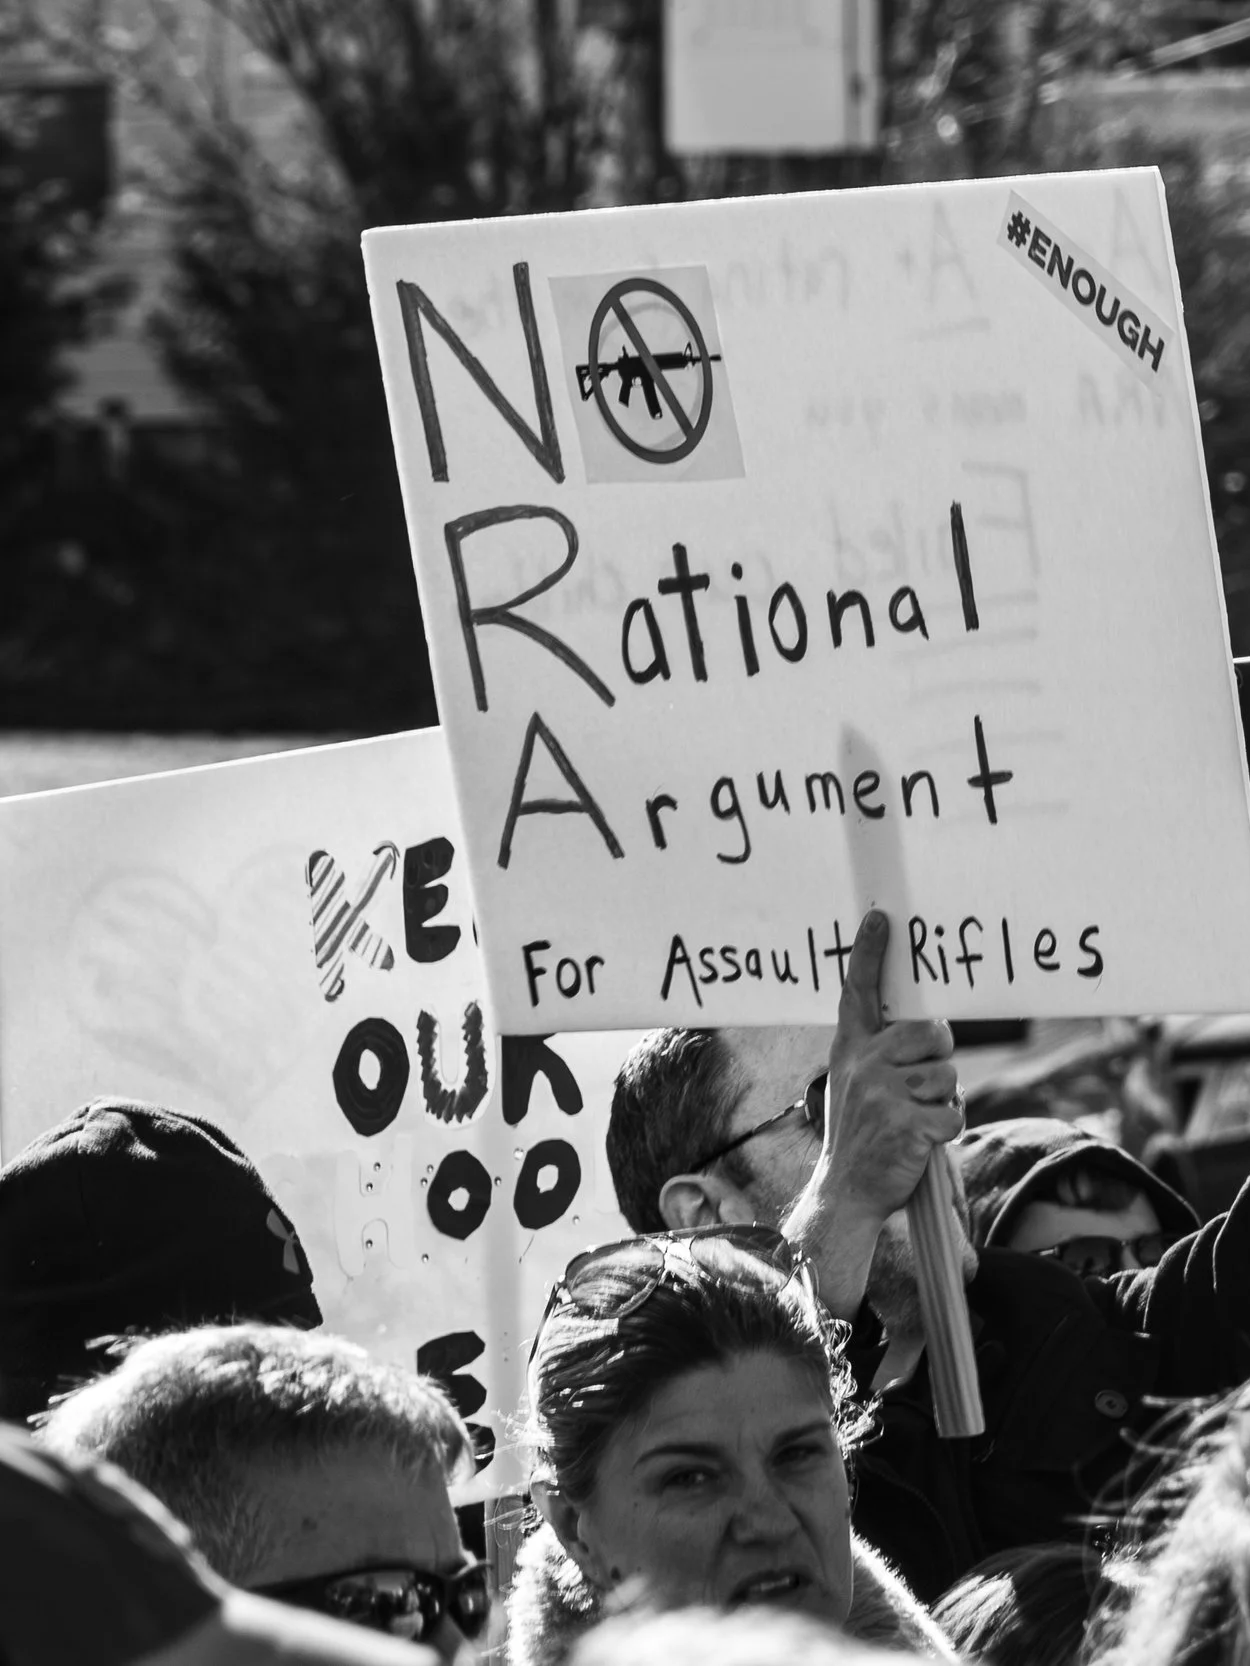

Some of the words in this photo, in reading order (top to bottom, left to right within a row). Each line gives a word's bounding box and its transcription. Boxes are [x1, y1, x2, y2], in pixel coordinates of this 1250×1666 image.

[1005, 210, 1165, 372] #ENOUGH
[443, 500, 980, 712] Rational
[496, 710, 1015, 870] Argument
[305, 837, 478, 1003] KE
[522, 939, 606, 1007] For
[661, 918, 856, 1007] Assault
[908, 915, 1105, 993] Rifles
[333, 1001, 584, 1137] OUR
